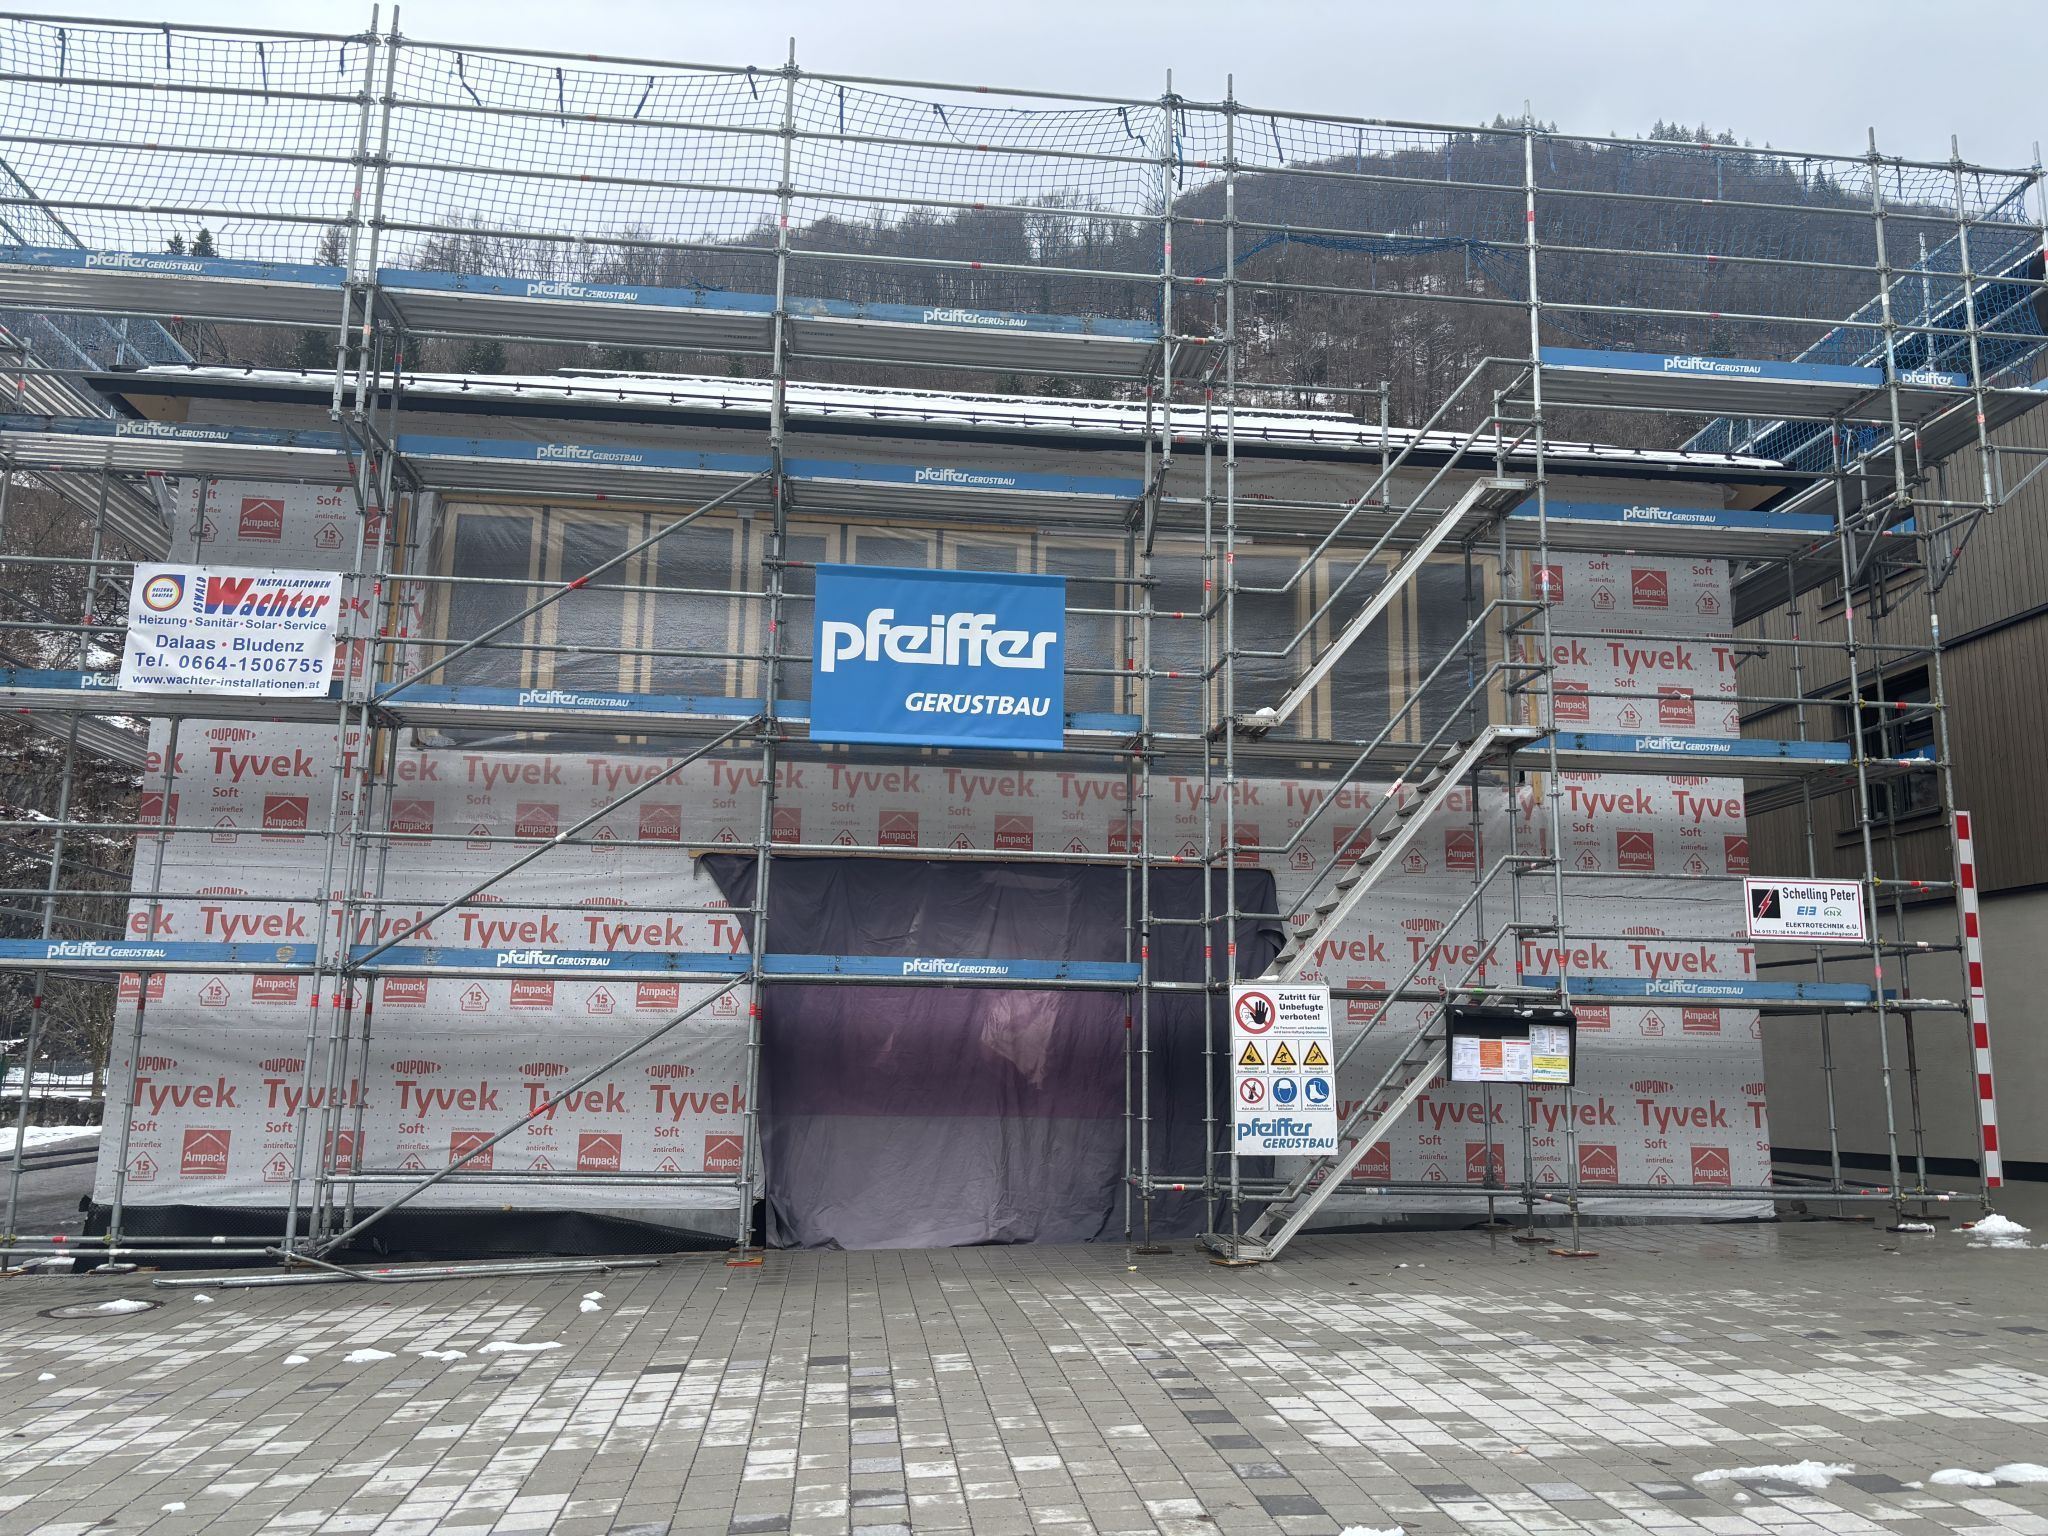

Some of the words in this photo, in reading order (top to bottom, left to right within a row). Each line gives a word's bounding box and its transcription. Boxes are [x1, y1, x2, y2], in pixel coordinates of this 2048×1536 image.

[85, 253, 148, 268] pfeiffer
[527, 281, 587, 298] pfeiffer
[924, 308, 978, 323] pfeiffer
[1664, 357, 1714, 372] pfeiffer
[116, 420, 178, 436] pfeiffer
[536, 444, 592, 459] pfeiffer
[915, 468, 970, 482] pfeiffer
[317, 496, 342, 506] Soft
[1623, 507, 1673, 520] pfeiffer
[242, 517, 280, 528] Ampack
[1589, 561, 1609, 570] Soft
[1693, 566, 1713, 575] Soft
[256, 579, 331, 588] INSTALLATIONEN
[193, 577, 206, 613] OSWALD
[205, 577, 330, 617] Wachter
[1634, 587, 1666, 597] Ampack
[139, 615, 187, 627] Heizung
[195, 618, 238, 628] Sanitär
[246, 619, 277, 629] Solar
[284, 621, 326, 630] Service
[156, 635, 216, 650] Dalaas
[233, 638, 304, 652] Bludenz
[821, 608, 1056, 672] pfeiffer
[135, 653, 169, 667] Tel.
[179, 655, 323, 673] 0664-1506755
[1607, 643, 1693, 674] Tyvek
[132, 675, 320, 689] www.wachter-installationen.at
[1615, 678, 1635, 687] Soft
[519, 689, 577, 706] pfeiffer
[906, 692, 1050, 716] GERÜSTBAU
[1555, 700, 1587, 710] Ampack
[1661, 705, 1693, 714] Ampack
[1625, 711, 1635, 719] 15
[1636, 736, 1686, 751] pfeiffer
[210, 747, 313, 782] Tyvek
[463, 756, 560, 789] Tyvek
[827, 765, 920, 799] Tyvek
[943, 768, 1034, 802] Tyvek
[213, 787, 239, 797] Soft
[832, 802, 855, 812] Soft
[1565, 786, 1652, 818] Tyvek
[265, 816, 304, 828] Ampack
[1573, 823, 1594, 833] Soft
[1680, 827, 1701, 837] Soft
[1584, 857, 1593, 865] 15
[1620, 851, 1652, 860] Ampack
[1783, 887, 1828, 903] Schelling
[1831, 889, 1856, 900] Peter
[201, 907, 306, 944] Tyvek
[459, 914, 559, 947] Tyvek
[1406, 920, 1440, 930] DUPONT
[584, 917, 684, 951] Tyvek
[47, 942, 112, 958] pfeiffer
[497, 951, 558, 967] pfeiffer
[1628, 944, 1716, 979] Tyvek
[903, 958, 959, 975] pfeiffer
[256, 978, 296, 990] Ampack
[1414, 976, 1436, 985] Soft
[208, 987, 222, 995] 15
[386, 982, 425, 993] Ampack
[514, 984, 552, 995] Ampack
[639, 987, 677, 998] Ampack
[1646, 979, 1699, 995] pfeiffer
[1684, 1011, 1718, 1021] Ampack
[397, 1062, 436, 1074] DUPONT
[524, 1064, 563, 1076] DUPONT
[651, 1065, 689, 1077] DUPONT
[1635, 1081, 1668, 1093] DUPONT
[396, 1081, 499, 1118] Tyvek
[1636, 1099, 1728, 1134] Tyvek
[266, 1122, 292, 1133] Soft
[398, 1124, 424, 1135] Soft
[528, 1125, 553, 1136] Soft
[654, 1128, 679, 1137] Soft
[1238, 1118, 1312, 1140] pfeiffer
[1263, 1138, 1334, 1148] GERÜSTBAU
[1419, 1135, 1441, 1145] Soft
[1533, 1137, 1554, 1146] Soft
[1645, 1139, 1667, 1149] Soft
[184, 1152, 225, 1162] Ampack
[579, 1155, 618, 1166] Ampack
[136, 1161, 149, 1170] 15
[273, 1161, 286, 1171] 15
[1582, 1165, 1615, 1175] Ampack
[1429, 1171, 1440, 1180] 15
[1543, 1173, 1554, 1182] 15
[1694, 1168, 1728, 1177] Ampack
